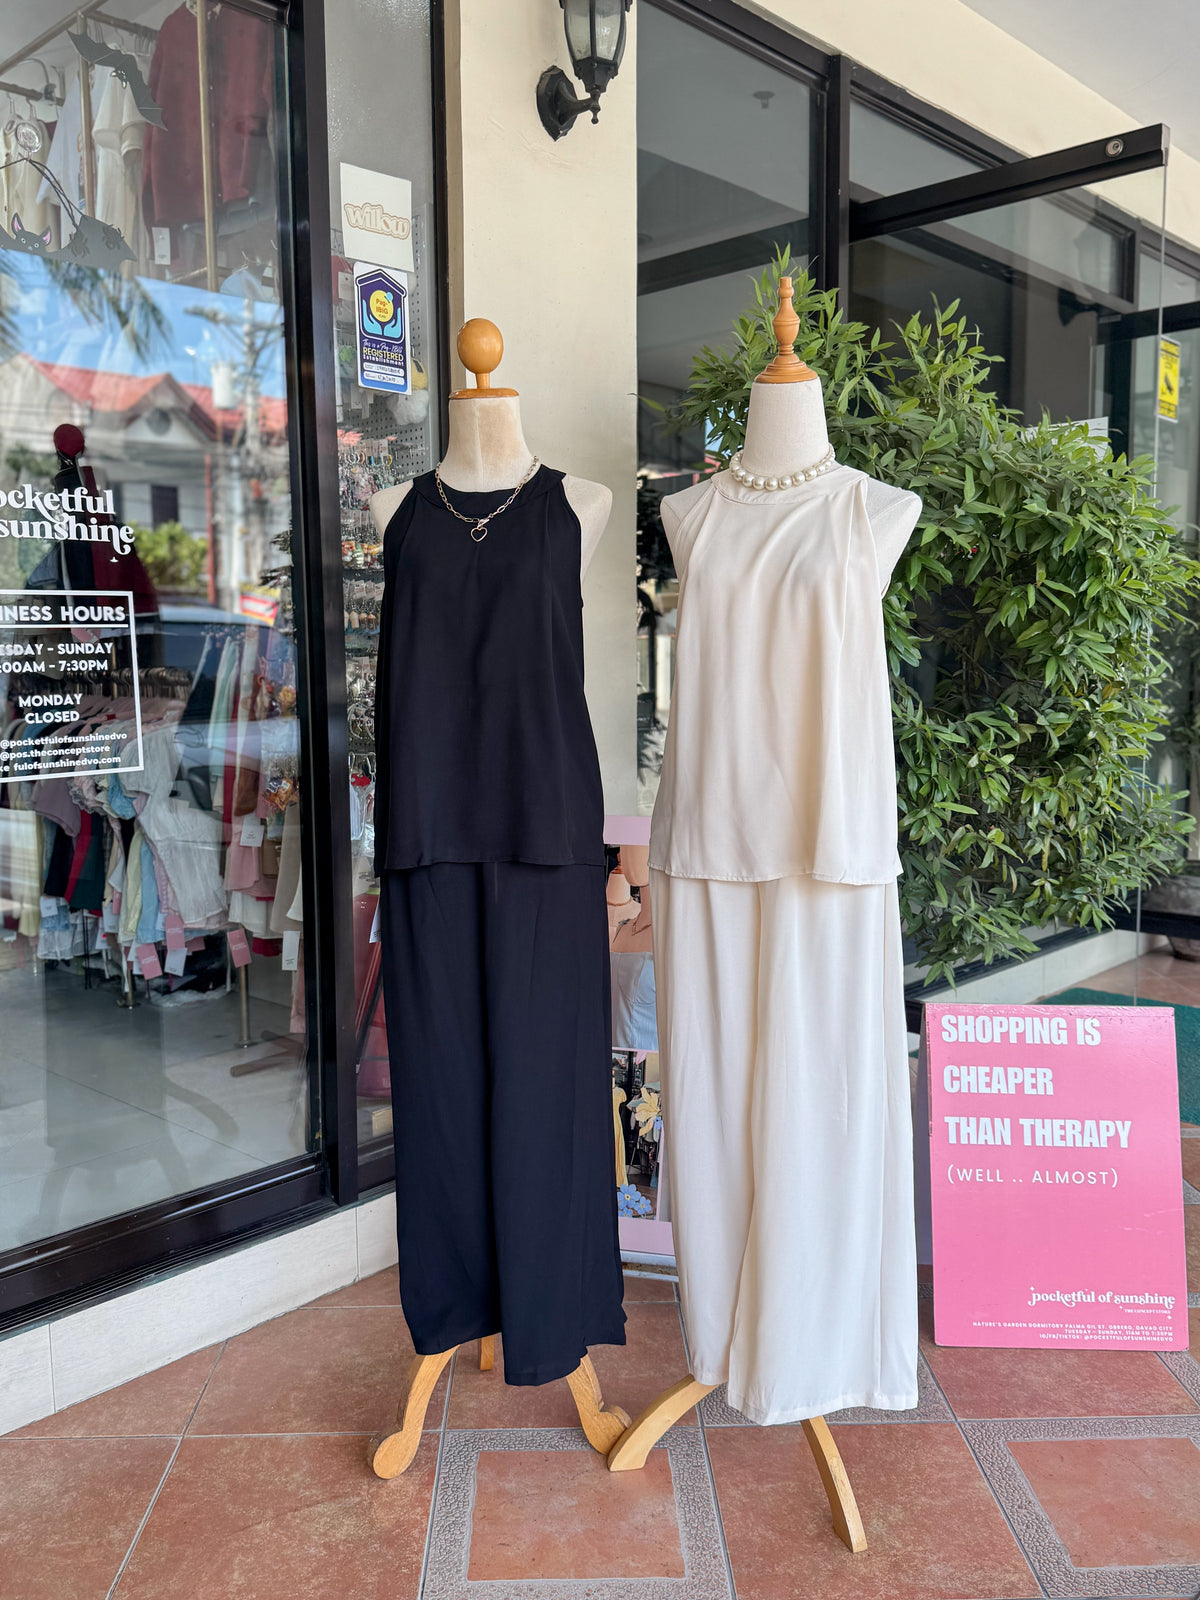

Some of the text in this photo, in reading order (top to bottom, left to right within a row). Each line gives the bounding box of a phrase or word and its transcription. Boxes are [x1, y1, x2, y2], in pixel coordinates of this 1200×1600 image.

[344, 203, 410, 240] willow
[363, 347, 404, 361] REGISTERED
[60, 605, 126, 621] HOURS
[57, 642, 113, 655] SUNDAY
[58, 659, 108, 672] 7:30PM
[18, 693, 83, 708] MONDAY
[25, 710, 80, 724] CLOSED
[0, 732, 128, 749] @pocketfulofsunshinedvo
[0, 745, 111, 761] @pos.theconceptstore
[13, 756, 122, 771] fulofsunshinedvo.com
[941, 1014, 1101, 1046] SHOPPING IS
[943, 1065, 1054, 1095] CHEAPER
[944, 1116, 1132, 1148] THAN THERAPY
[947, 1164, 1004, 1185] (WELL
[1031, 1168, 1118, 1188] ALMOST)
[1027, 1290, 1176, 1310] pocketful of sunshine
[1084, 1334, 1174, 1342] @POCKETFULOFSUNSHINEDVO
